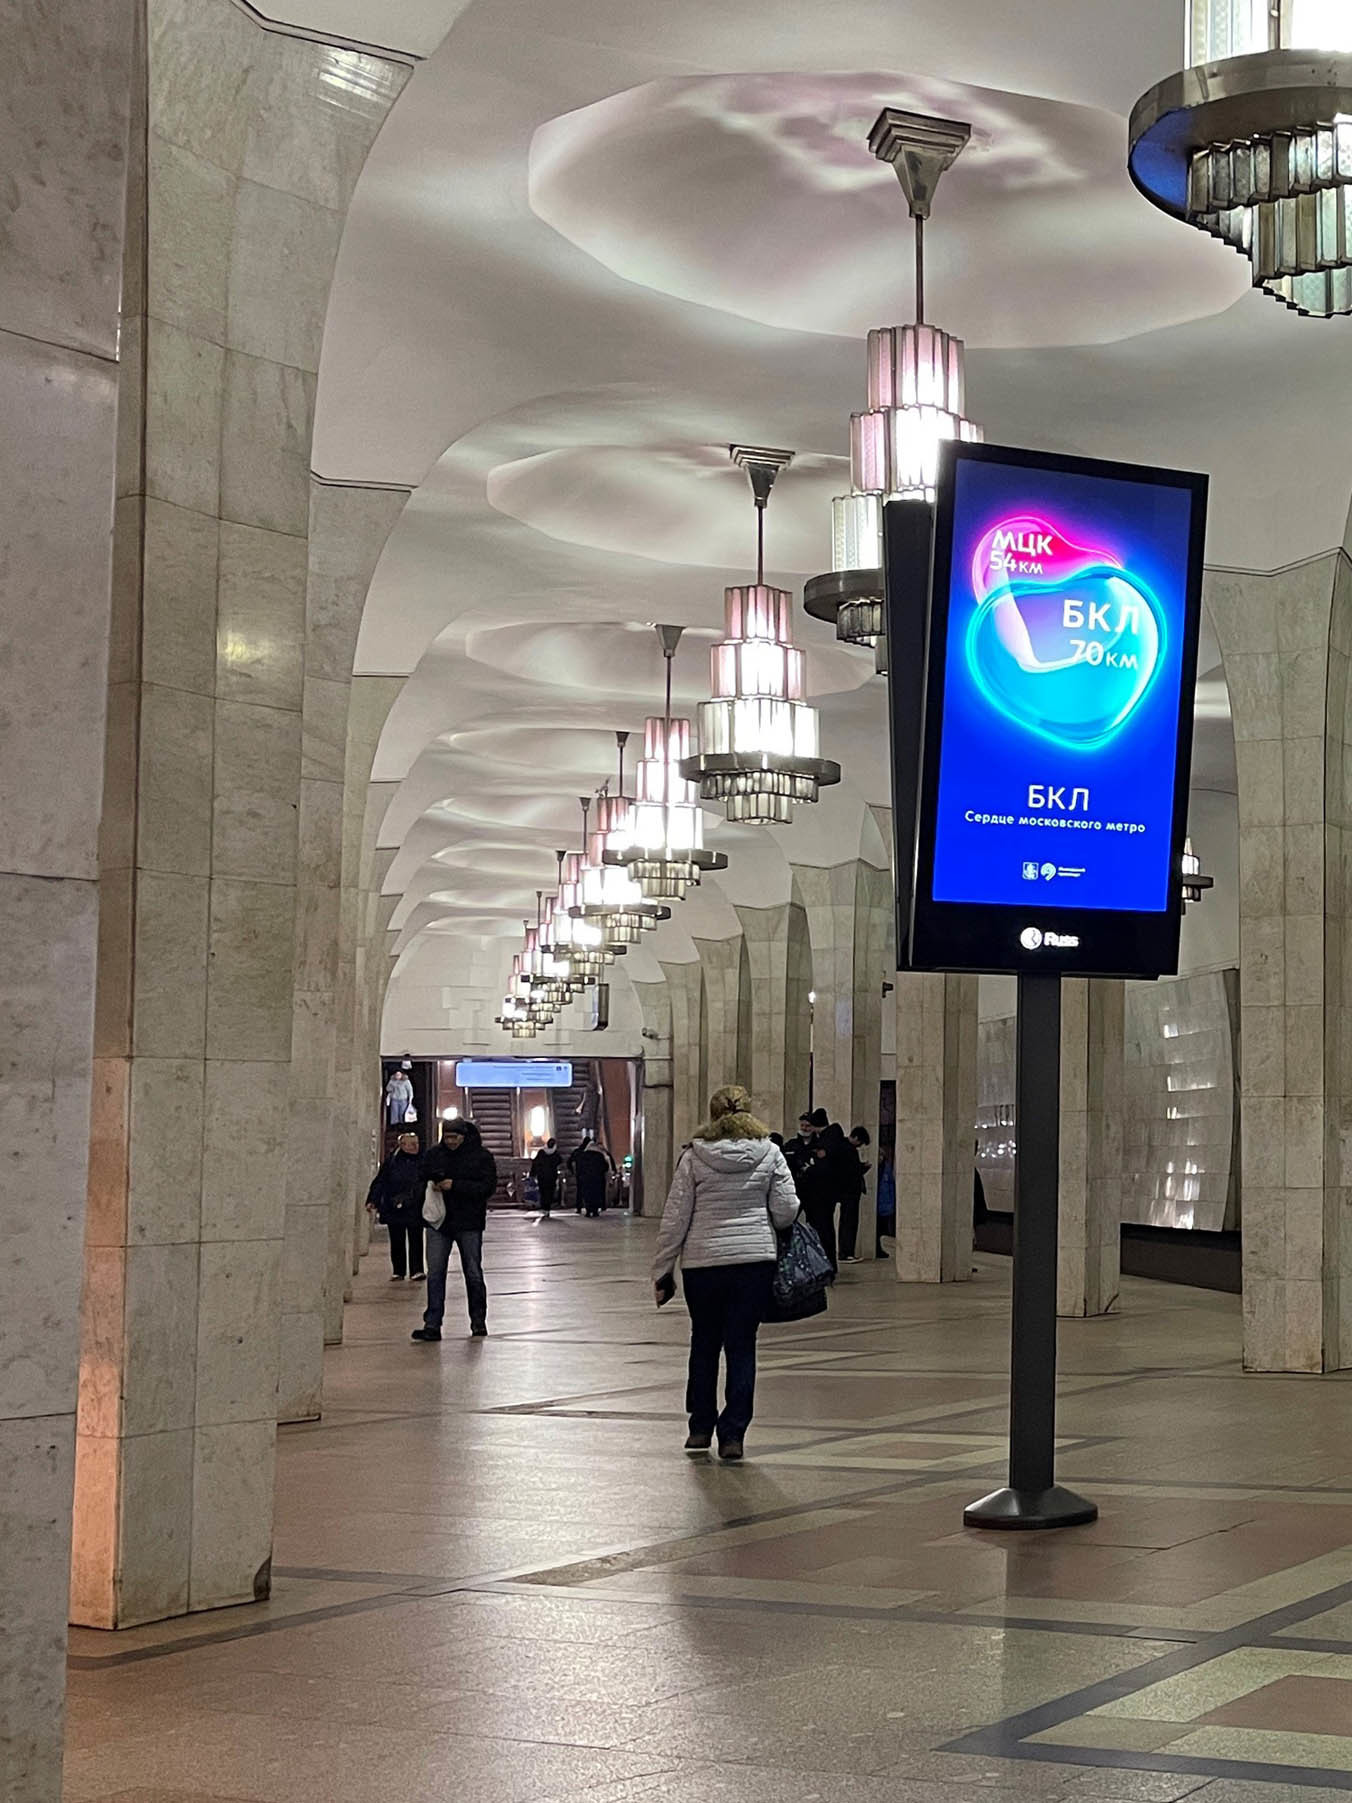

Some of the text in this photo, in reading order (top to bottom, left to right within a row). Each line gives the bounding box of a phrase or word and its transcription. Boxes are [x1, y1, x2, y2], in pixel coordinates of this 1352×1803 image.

[992, 529, 1053, 557] МЦК
[1063, 599, 1140, 635] БКЛ
[1028, 784, 1090, 811] БКЛ
[964, 810, 1146, 834] Сердце московского метро
